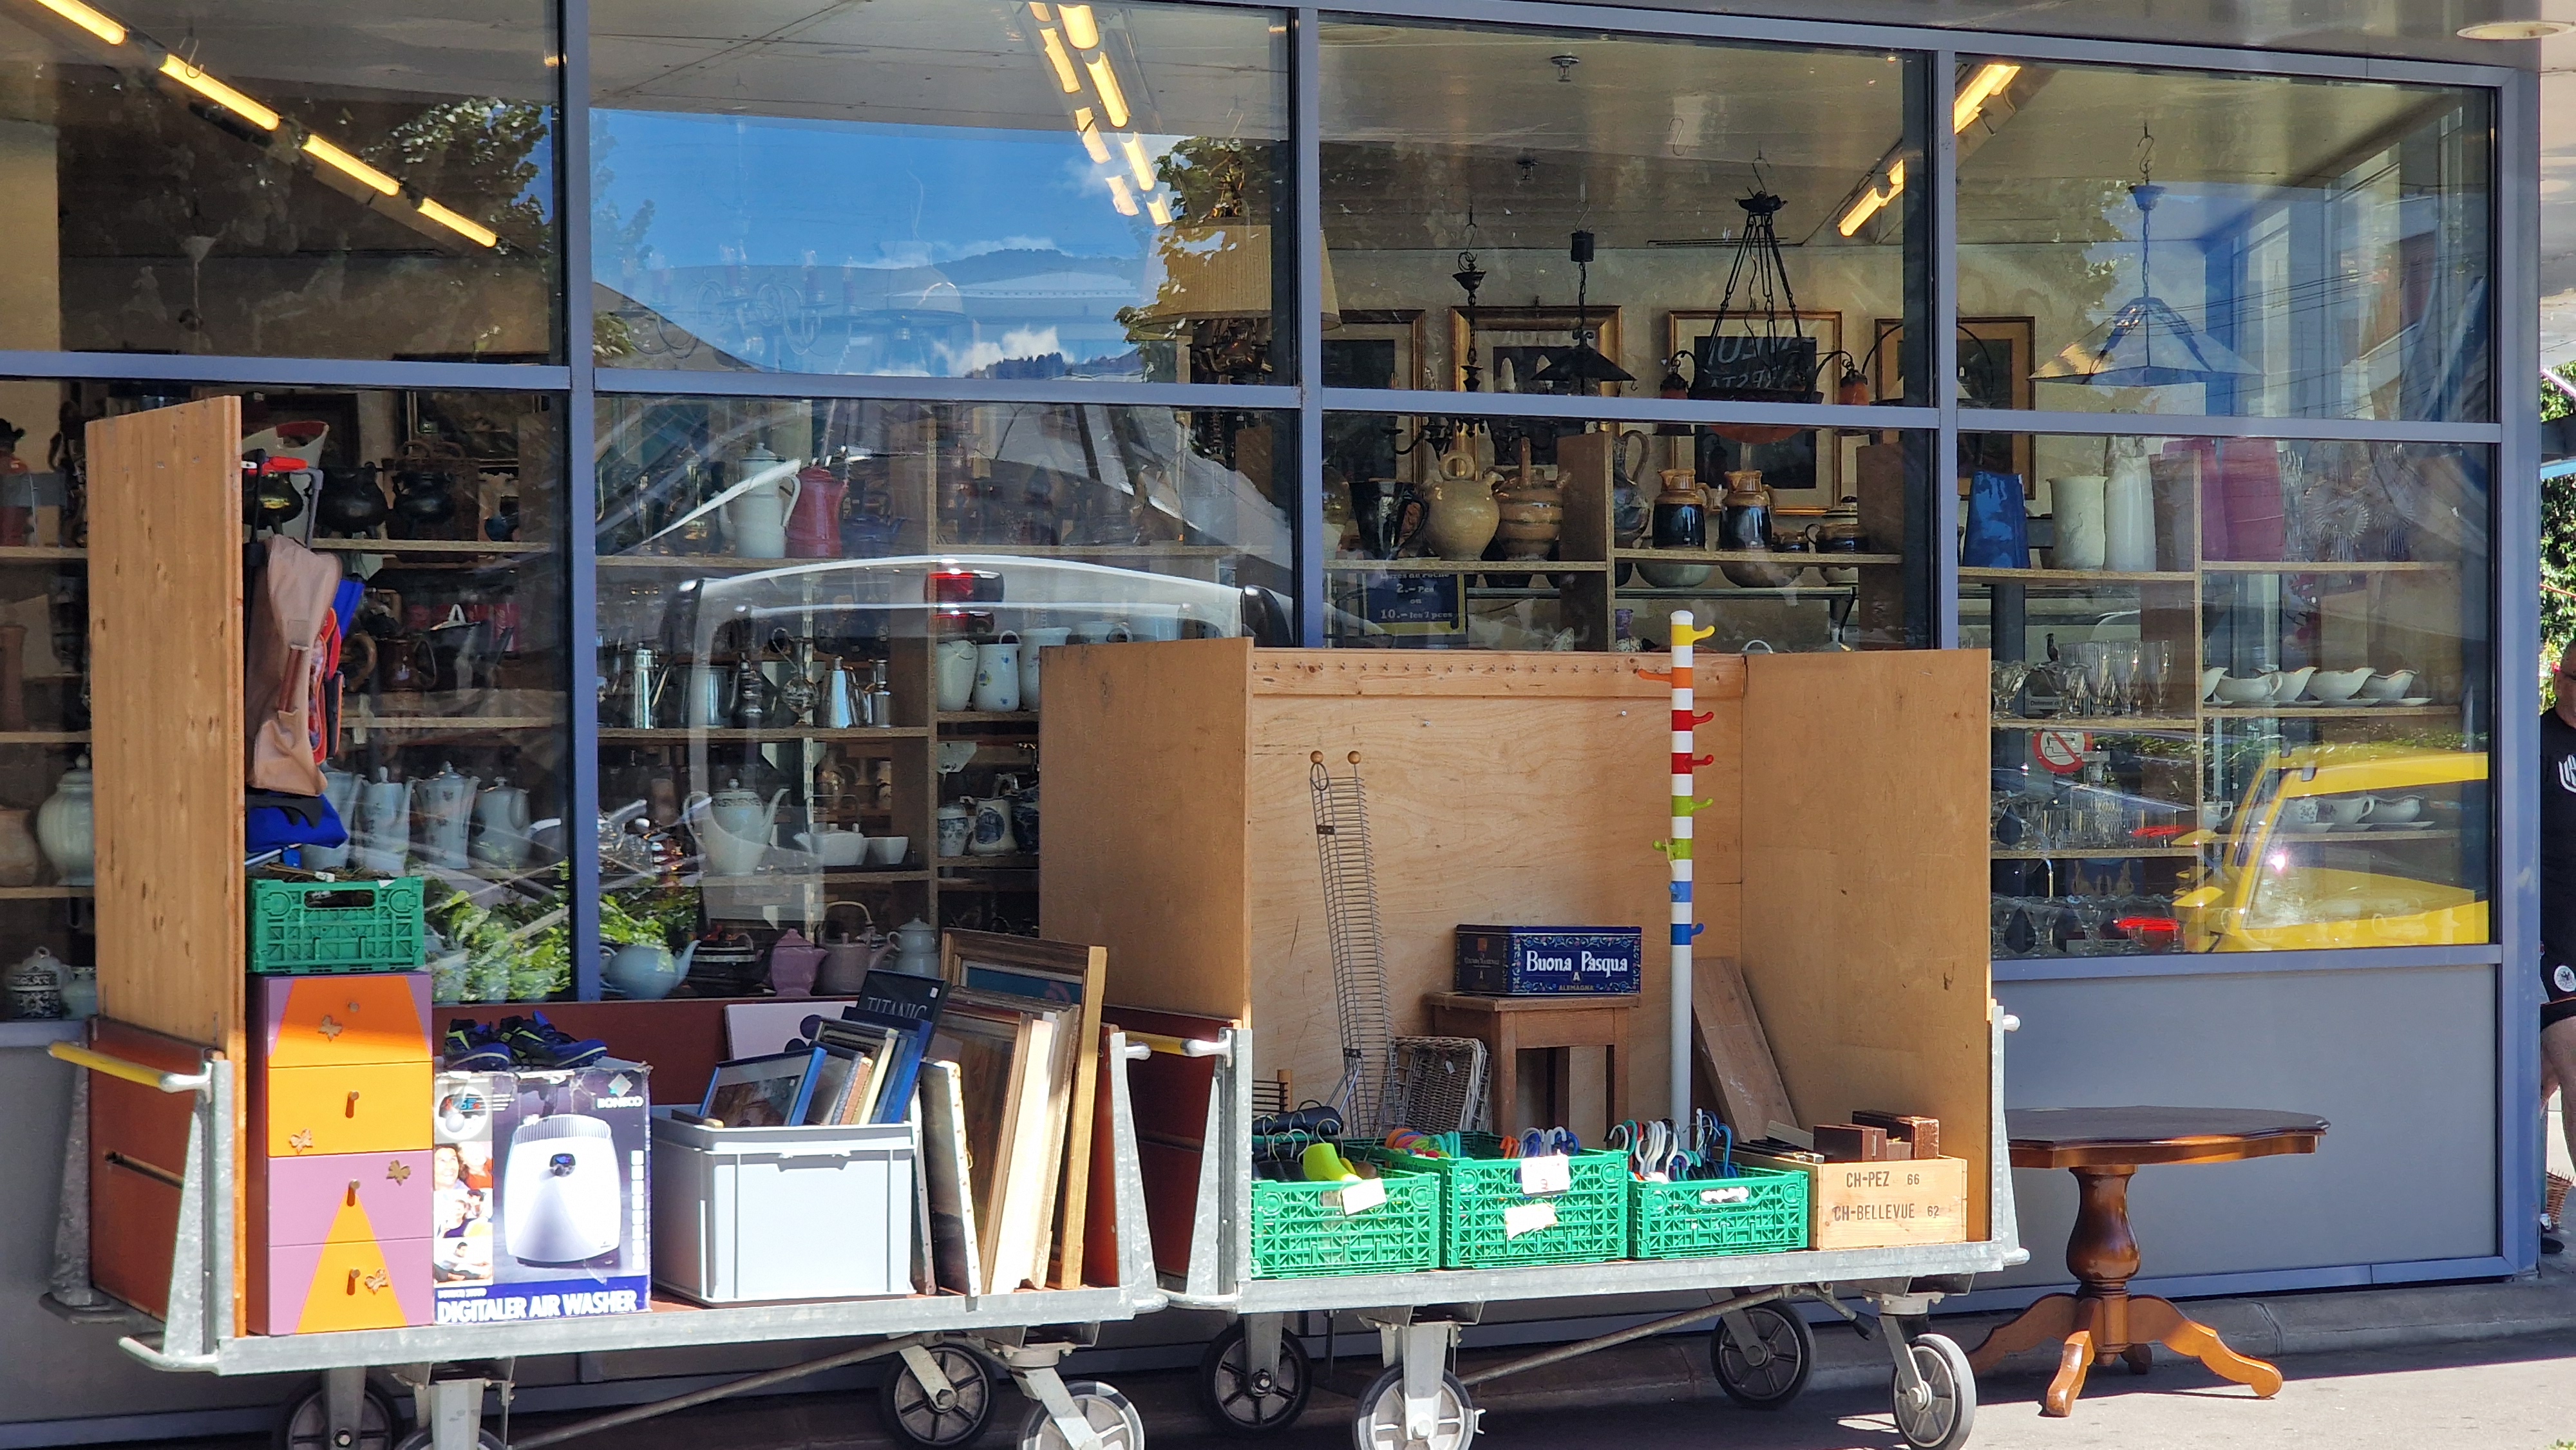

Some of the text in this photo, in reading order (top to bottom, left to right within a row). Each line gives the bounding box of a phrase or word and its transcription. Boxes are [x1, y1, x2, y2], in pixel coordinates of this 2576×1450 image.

[1381, 609, 1408, 619] 10.-
[1526, 951, 1571, 972] Buona
[1581, 951, 1627, 977] Pasqua
[1573, 972, 1580, 981] A
[867, 997, 927, 1019] TITANIC
[1846, 1171, 1920, 1187] CH-PEZ 66
[1833, 1203, 1939, 1221] CH-BELLEVUE 62
[437, 1290, 637, 1323] DIGITALER AIR WASHER
